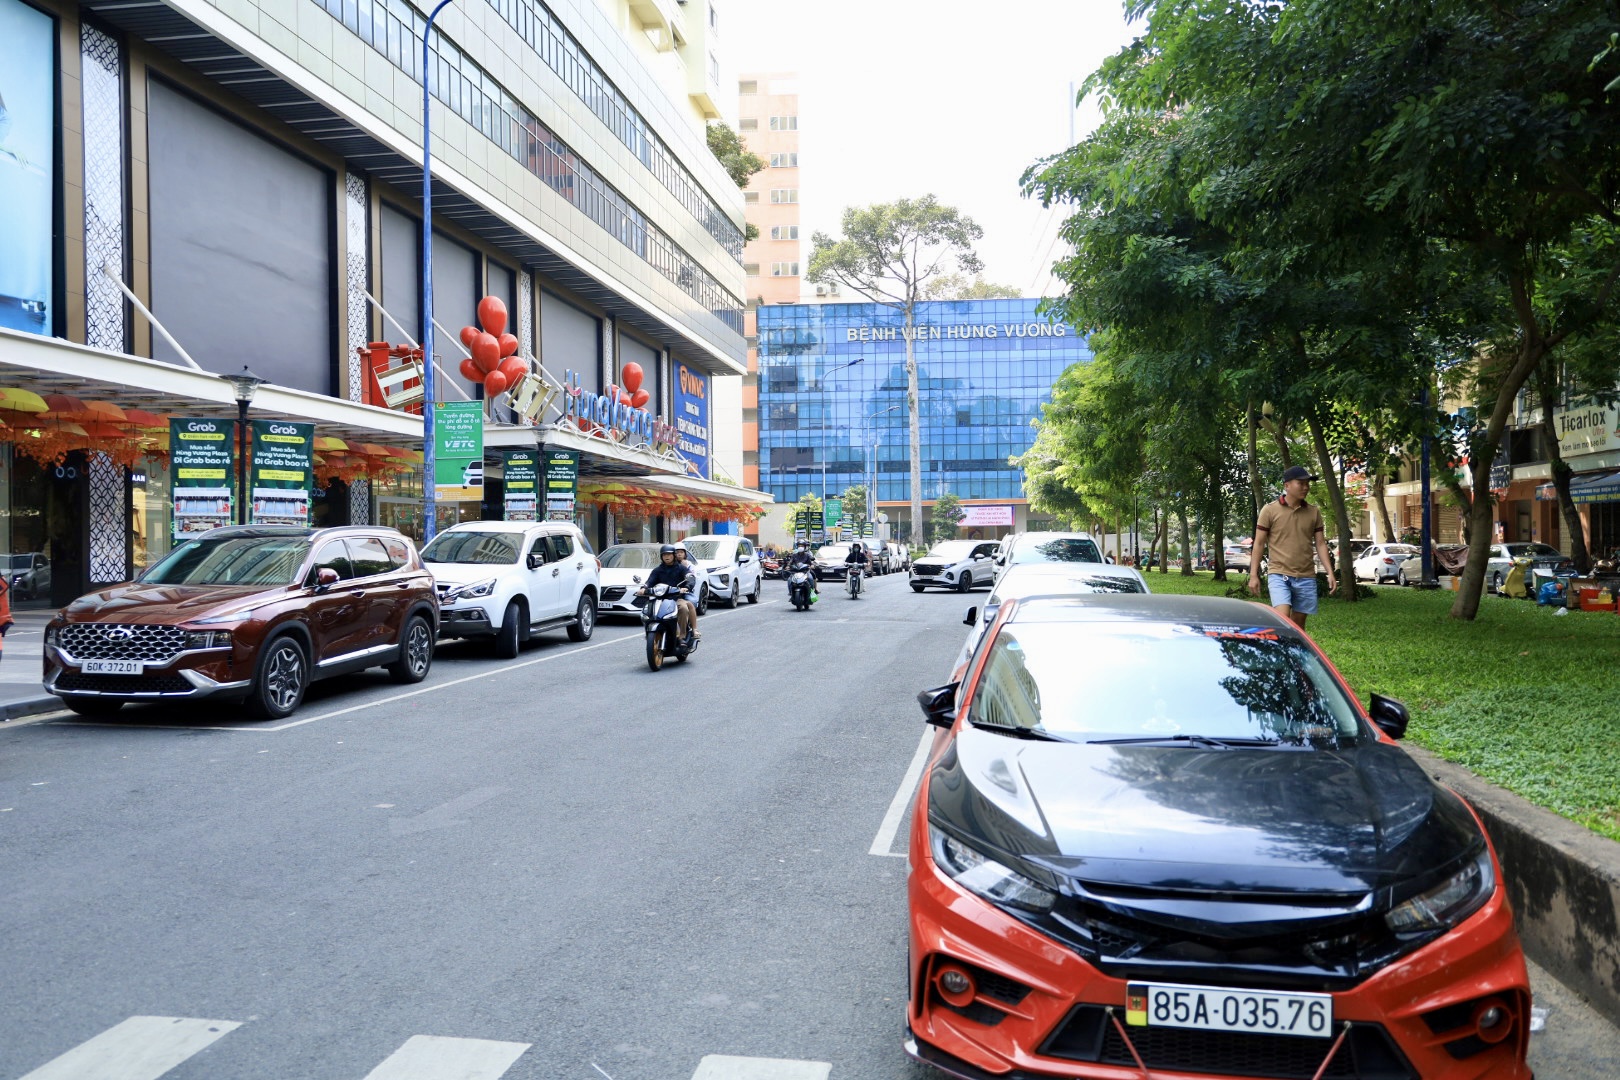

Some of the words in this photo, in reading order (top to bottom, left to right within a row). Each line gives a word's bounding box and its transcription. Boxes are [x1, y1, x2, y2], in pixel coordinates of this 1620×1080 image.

[847, 326, 896, 344] BỆNH
[947, 322, 998, 339] HÙNG
[1004, 322, 1066, 338] VƯƠNG
[687, 372, 704, 399] VNVC
[188, 422, 216, 432] Grab
[1560, 410, 1606, 432] Ticarlox
[270, 425, 297, 434] Grab
[1205, 632, 1279, 640] RACING
[87, 662, 137, 672] 60K-372.01
[1154, 991, 1326, 1032] 85A-035.76
